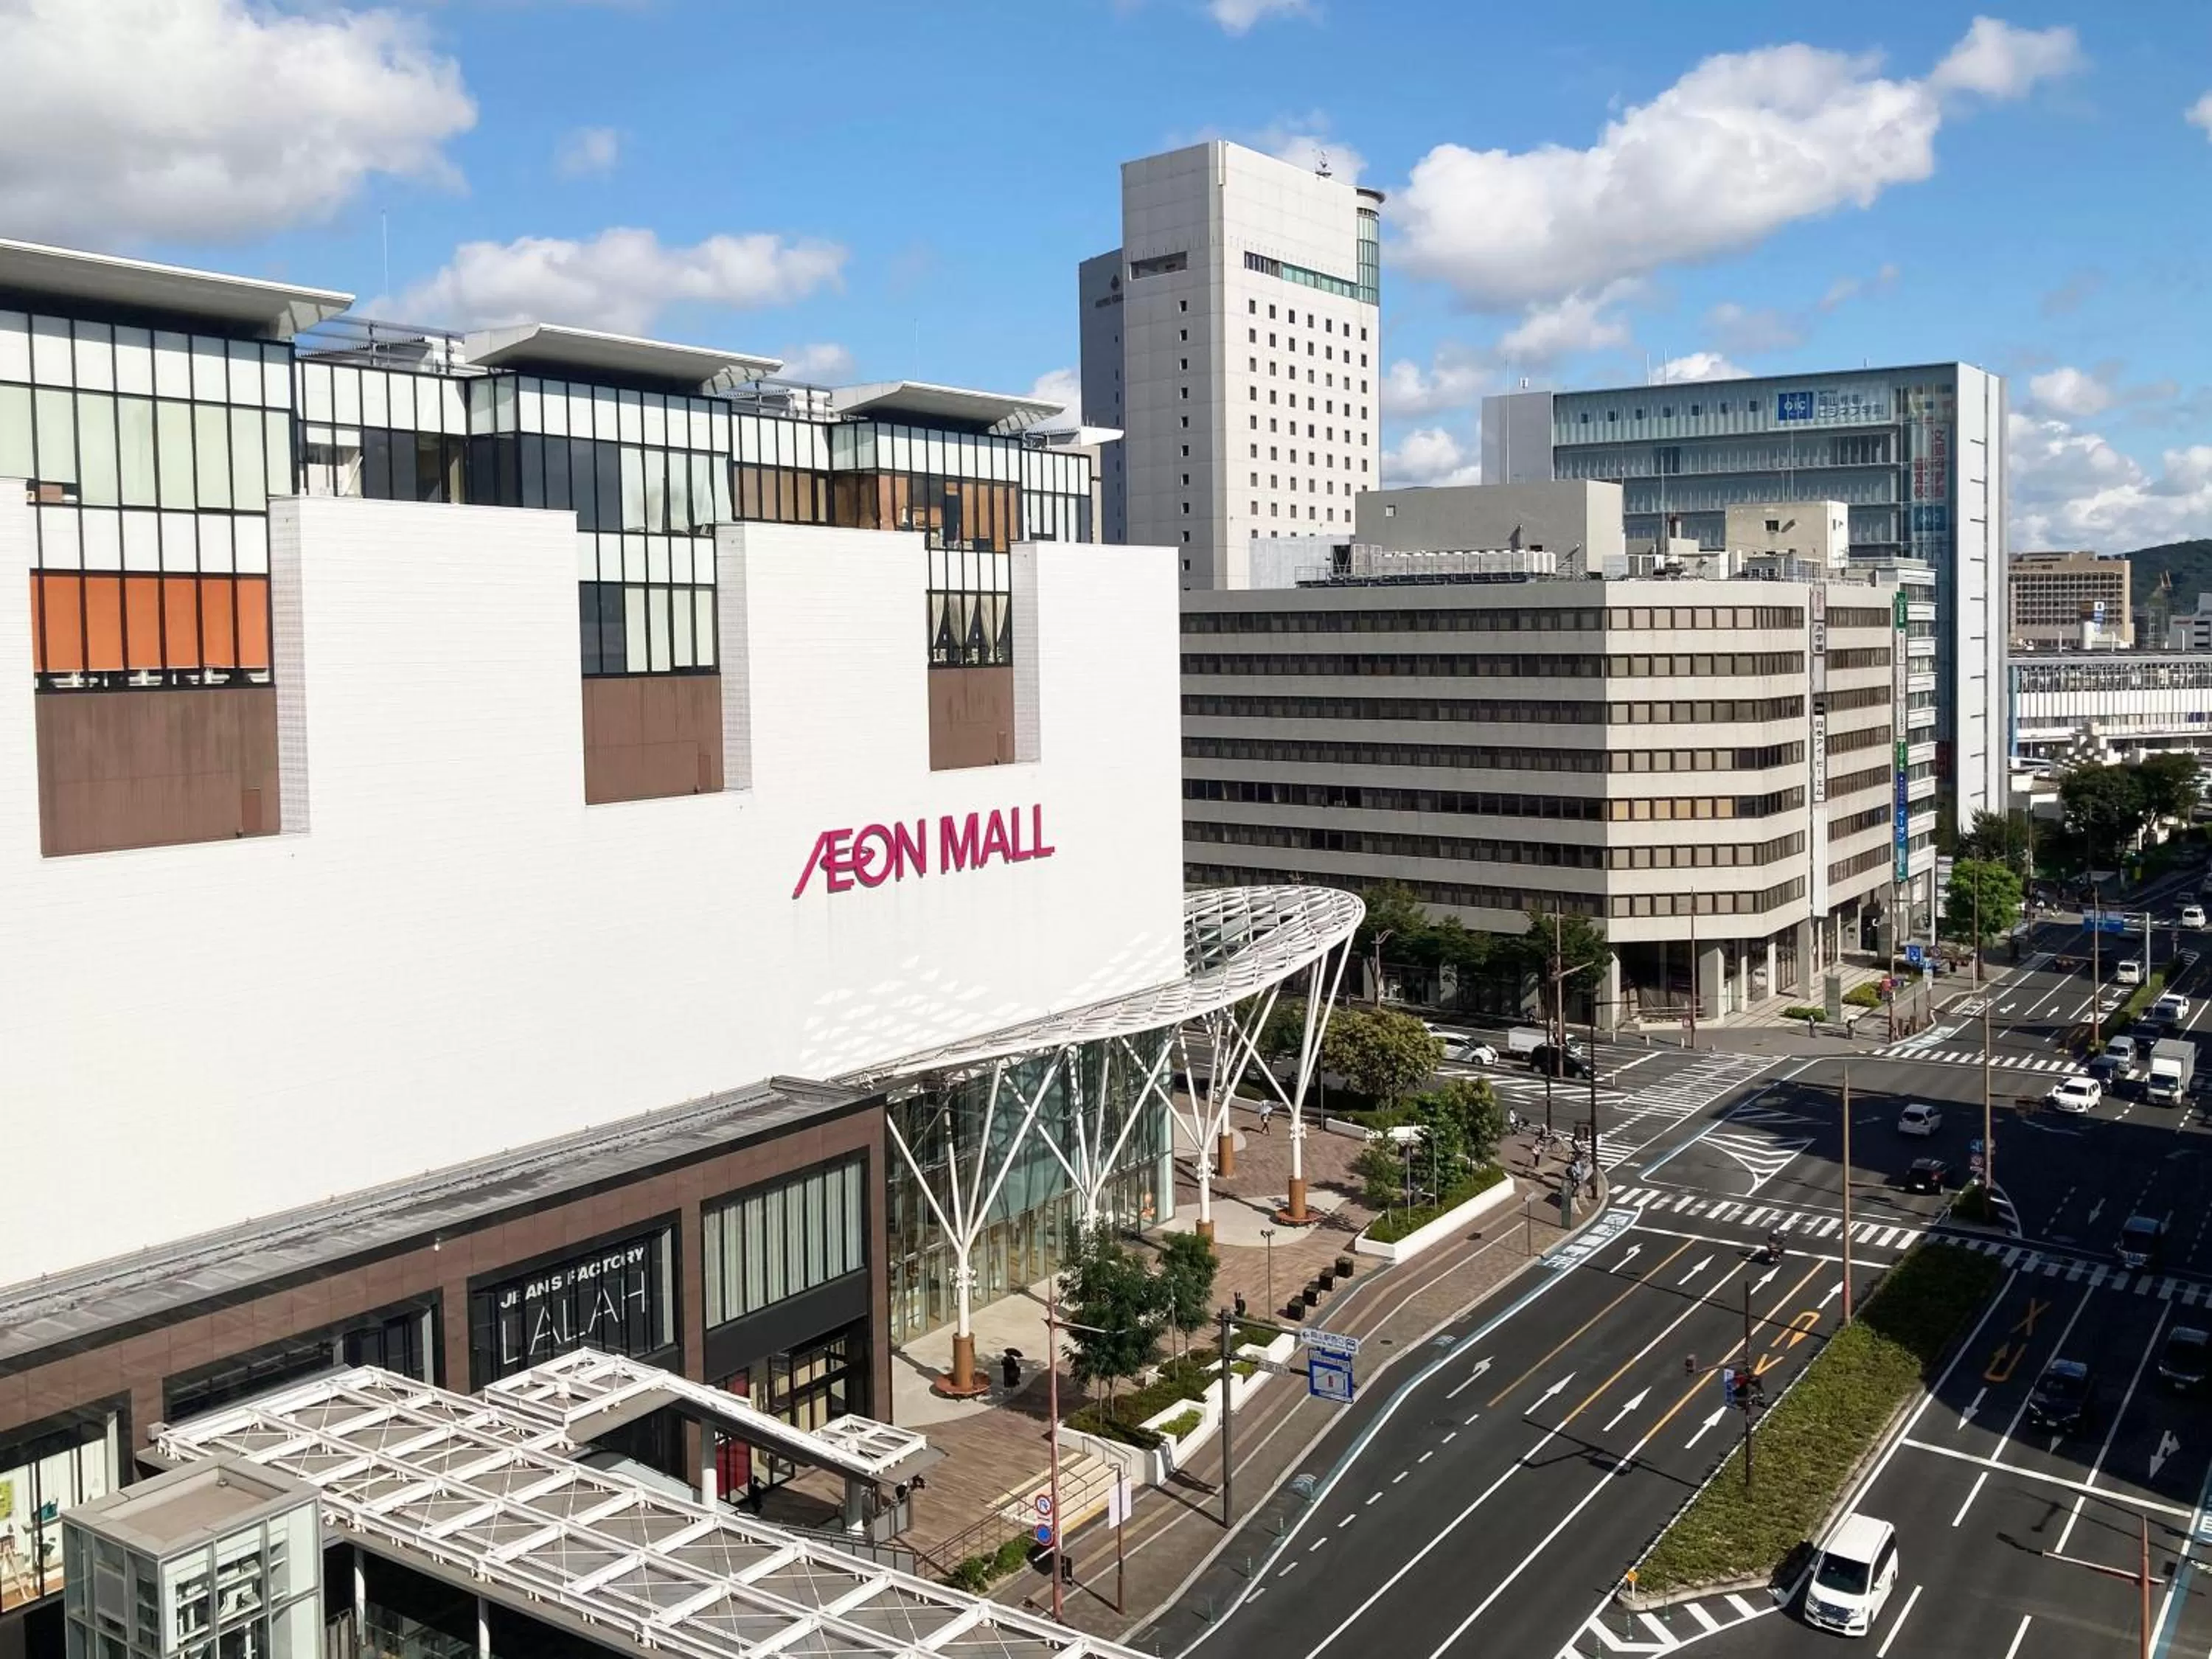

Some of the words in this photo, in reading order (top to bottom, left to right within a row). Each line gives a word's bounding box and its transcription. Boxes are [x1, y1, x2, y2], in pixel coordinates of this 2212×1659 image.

[939, 804, 1055, 875] MALL
[500, 1276, 563, 1309] JEANS
[567, 1246, 644, 1286] FACTORY
[502, 1270, 646, 1365] LALAH
